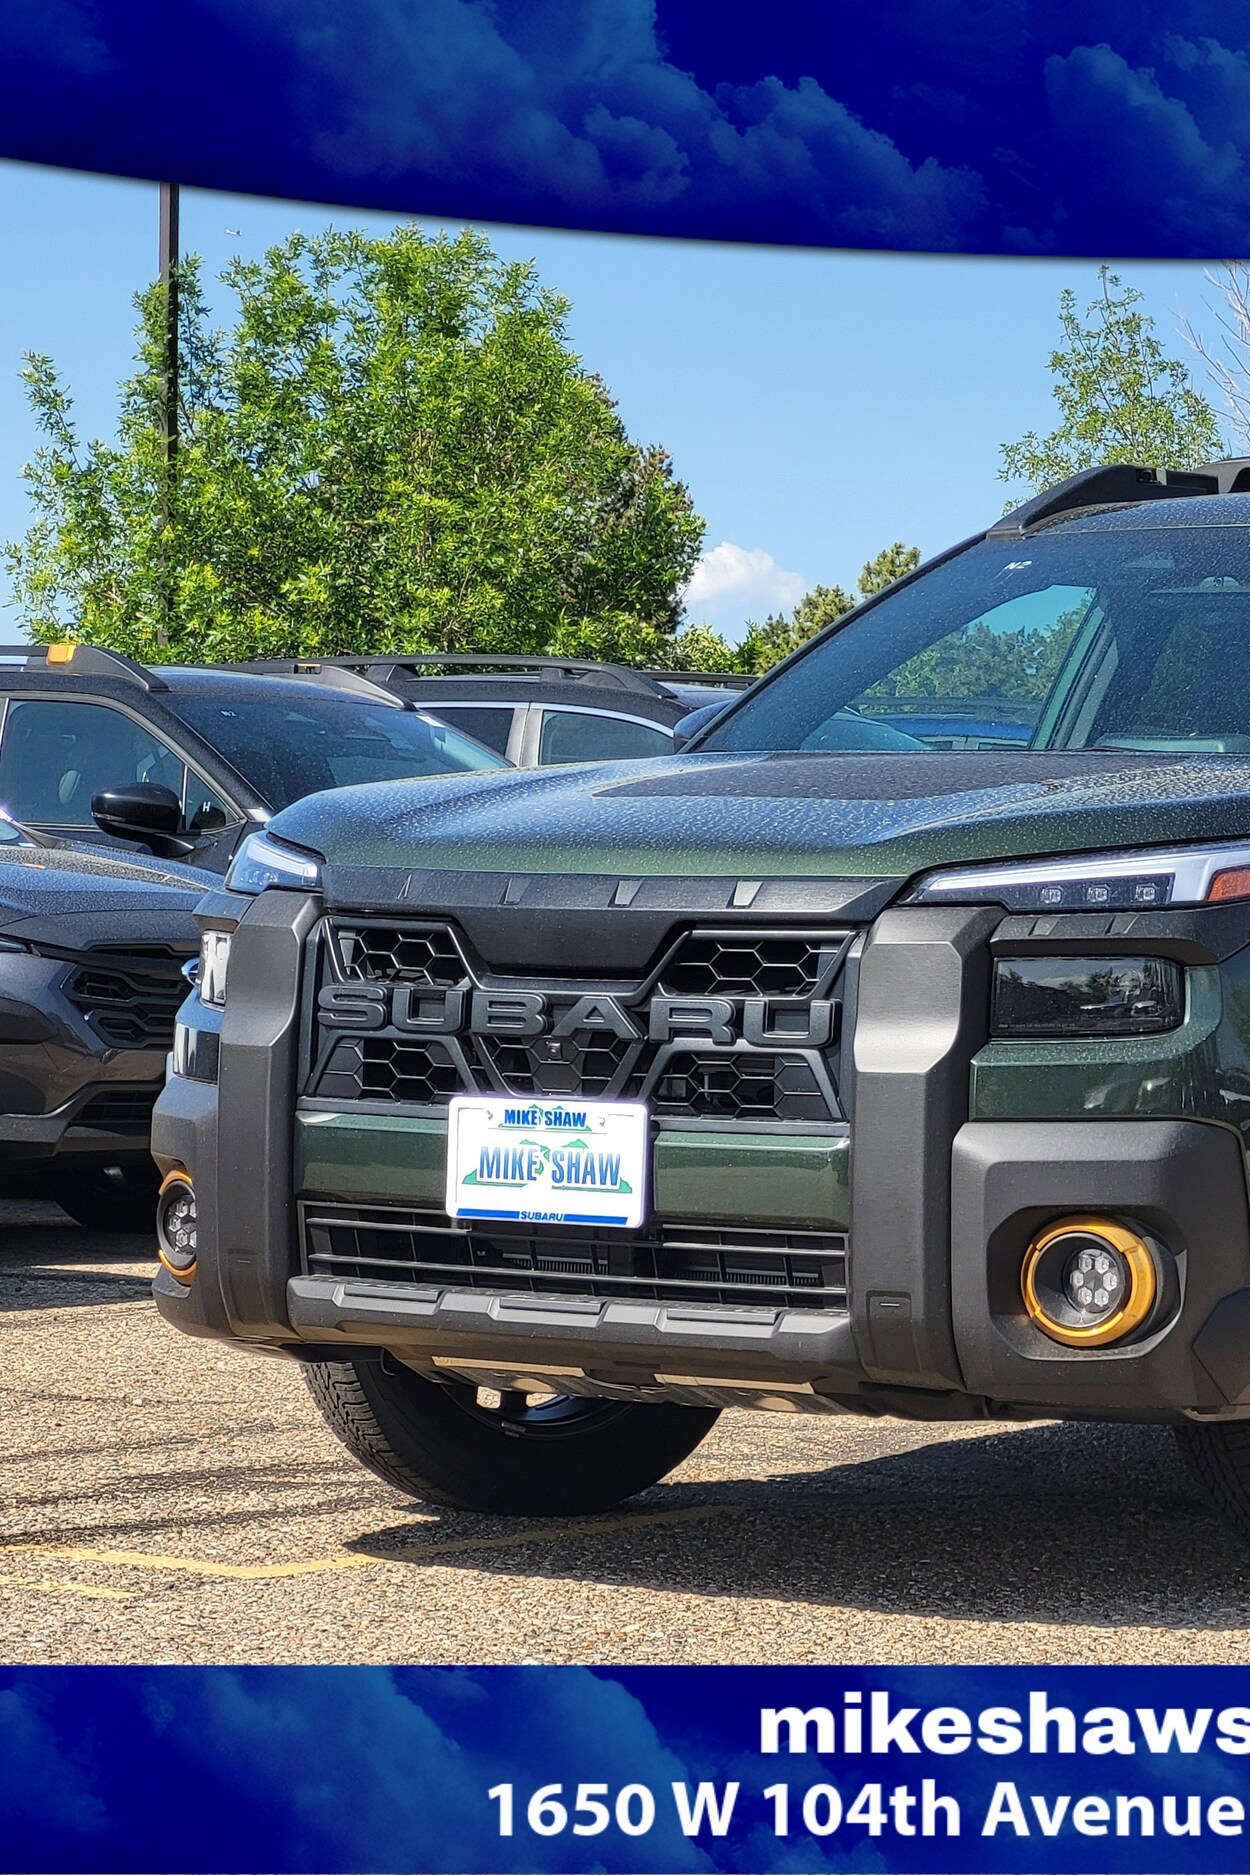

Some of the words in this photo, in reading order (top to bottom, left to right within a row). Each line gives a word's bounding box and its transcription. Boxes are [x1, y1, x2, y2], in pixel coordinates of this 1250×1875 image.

[317, 982, 843, 1048] SUBARU
[504, 1109, 538, 1126] MIKE
[544, 1110, 587, 1128] SHAW
[479, 1146, 538, 1181] MIKE
[551, 1149, 621, 1186] SHAW
[520, 1210, 564, 1222] SUBARU
